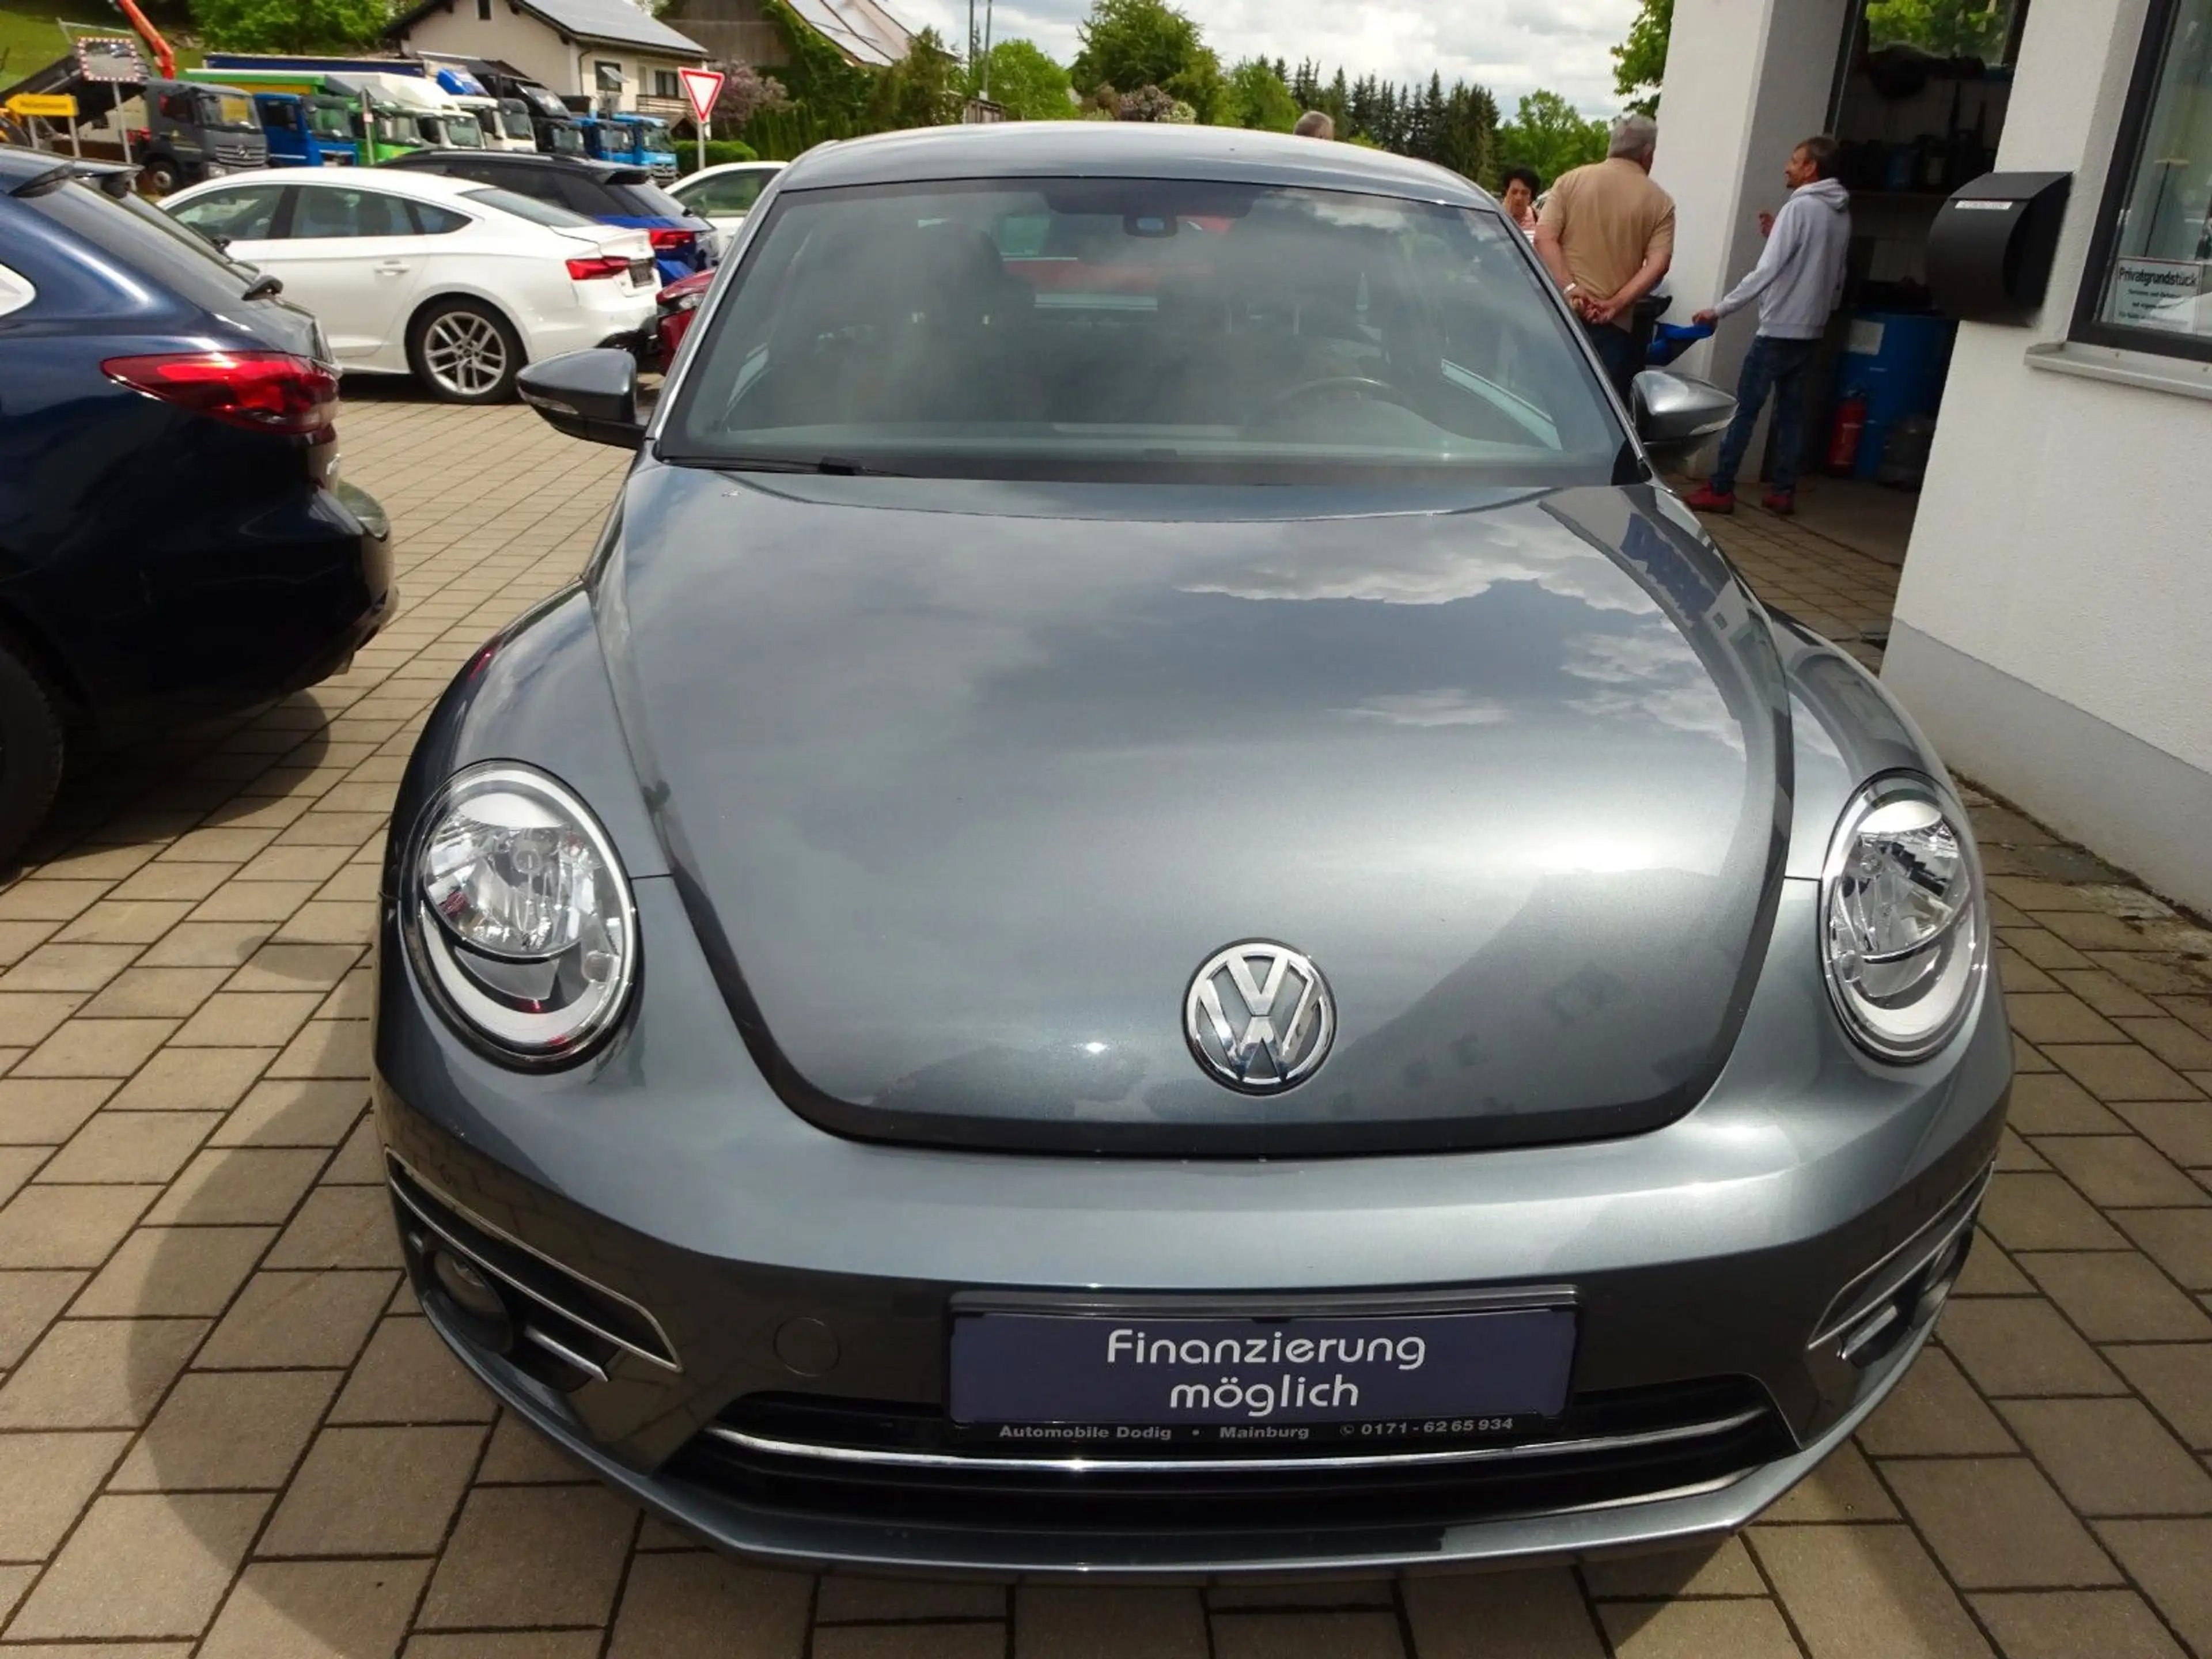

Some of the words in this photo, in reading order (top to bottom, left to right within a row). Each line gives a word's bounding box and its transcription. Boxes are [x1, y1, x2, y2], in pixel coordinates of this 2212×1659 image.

[1107, 1328, 1426, 1370] Finanzierung
[1169, 1373, 1359, 1418] möglich
[998, 1425, 1109, 1438] Automobile
[1116, 1426, 1172, 1441] Dodig
[1219, 1425, 1310, 1440] Mainburg
